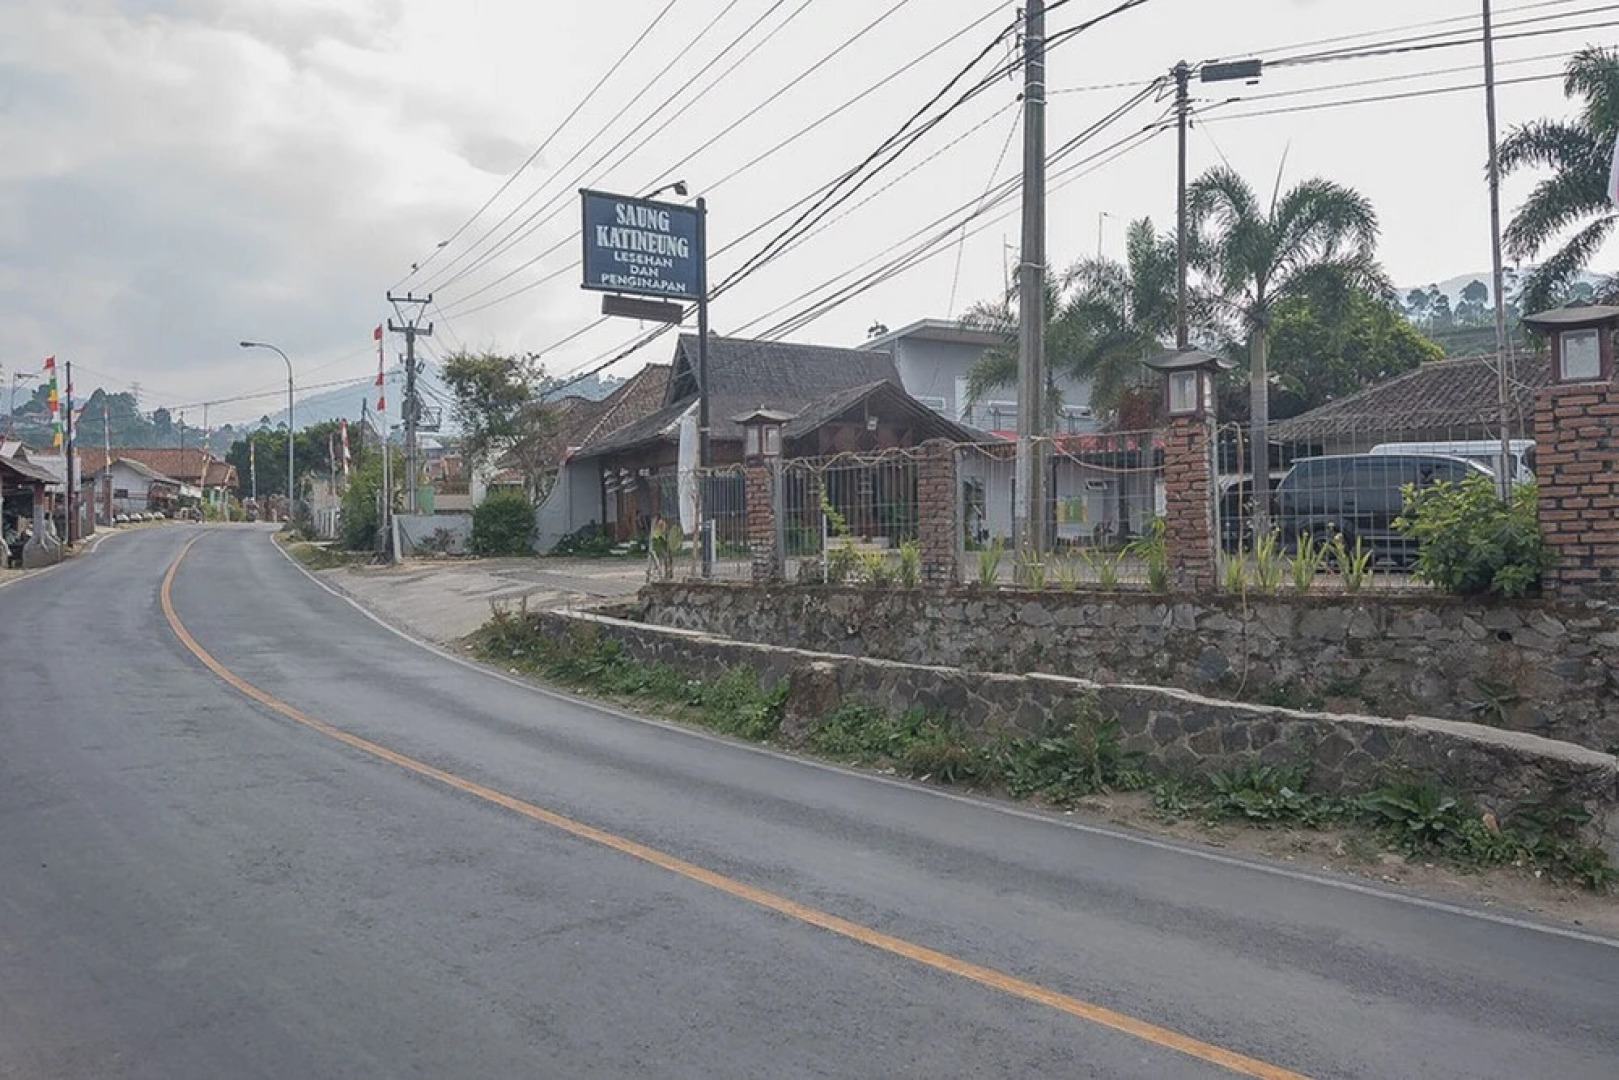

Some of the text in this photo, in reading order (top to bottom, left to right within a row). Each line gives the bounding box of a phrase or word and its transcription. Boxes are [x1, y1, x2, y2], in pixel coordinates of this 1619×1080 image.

[616, 202, 670, 232] SAUNG
[596, 224, 689, 259] KATINEUNG
[614, 251, 673, 268] LESEHAN
[630, 265, 659, 277] DAN
[601, 273, 686, 292] PENGINAPAN
